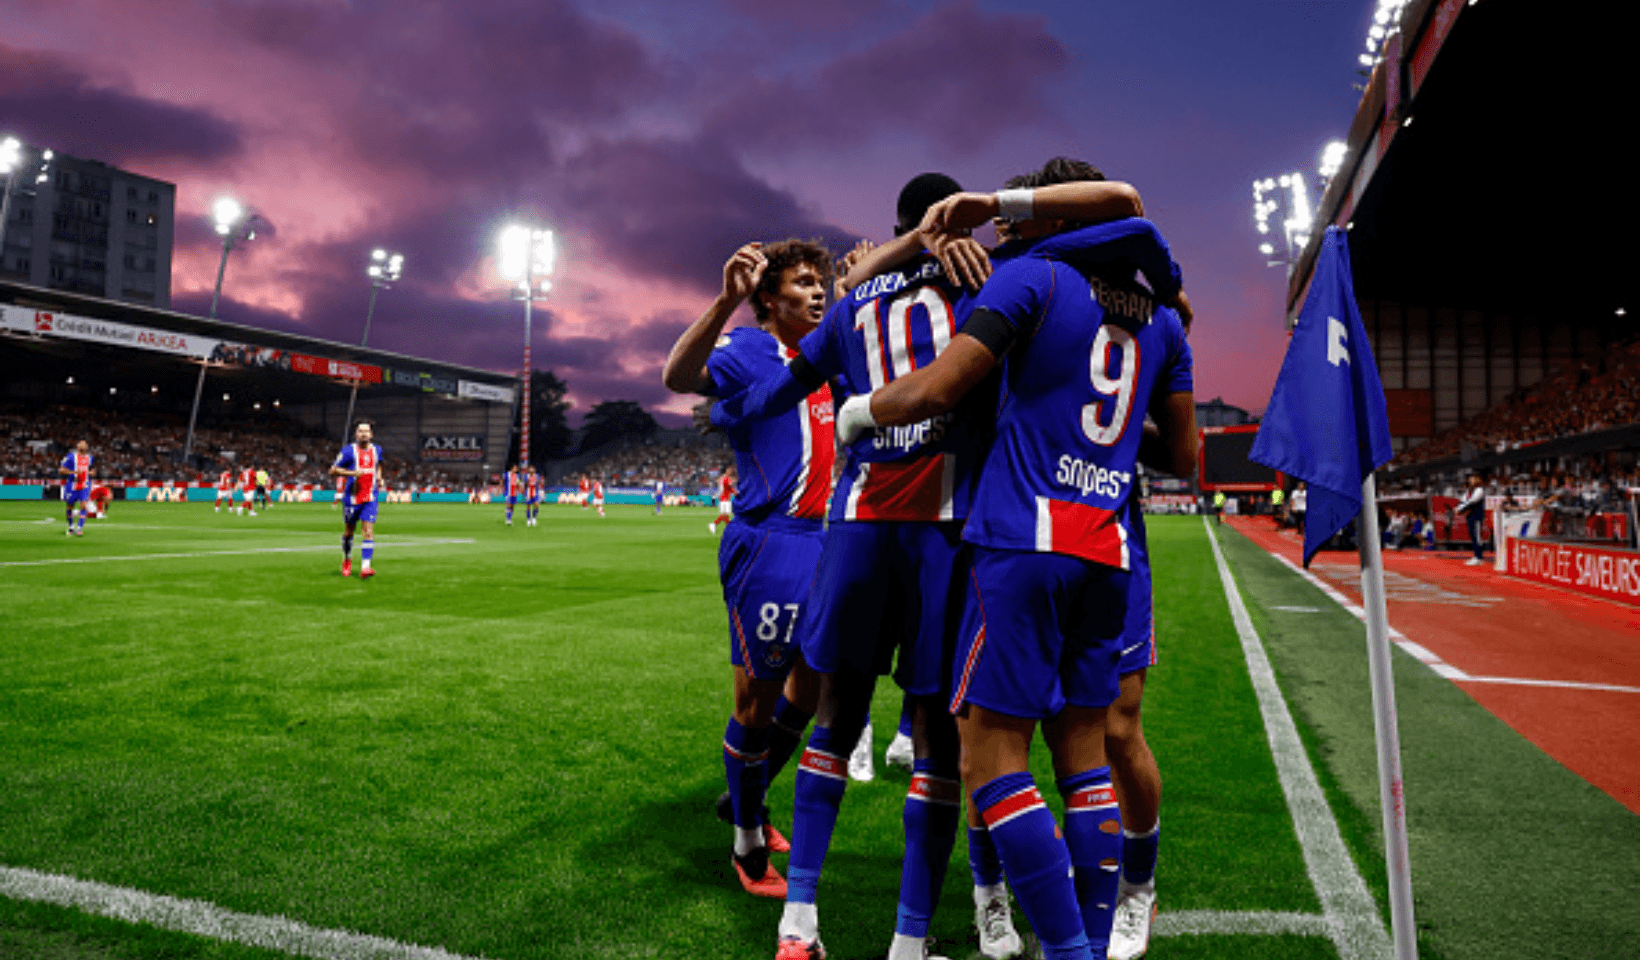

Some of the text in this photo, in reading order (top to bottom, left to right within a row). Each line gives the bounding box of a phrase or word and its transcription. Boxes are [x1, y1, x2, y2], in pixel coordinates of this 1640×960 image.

[853, 285, 956, 394] 10
[1081, 323, 1142, 447] 9
[424, 436, 482, 449] AXEL
[1056, 453, 1122, 499] snipes
[1576, 551, 1640, 597] SAVEURS
[756, 602, 799, 643] 87
